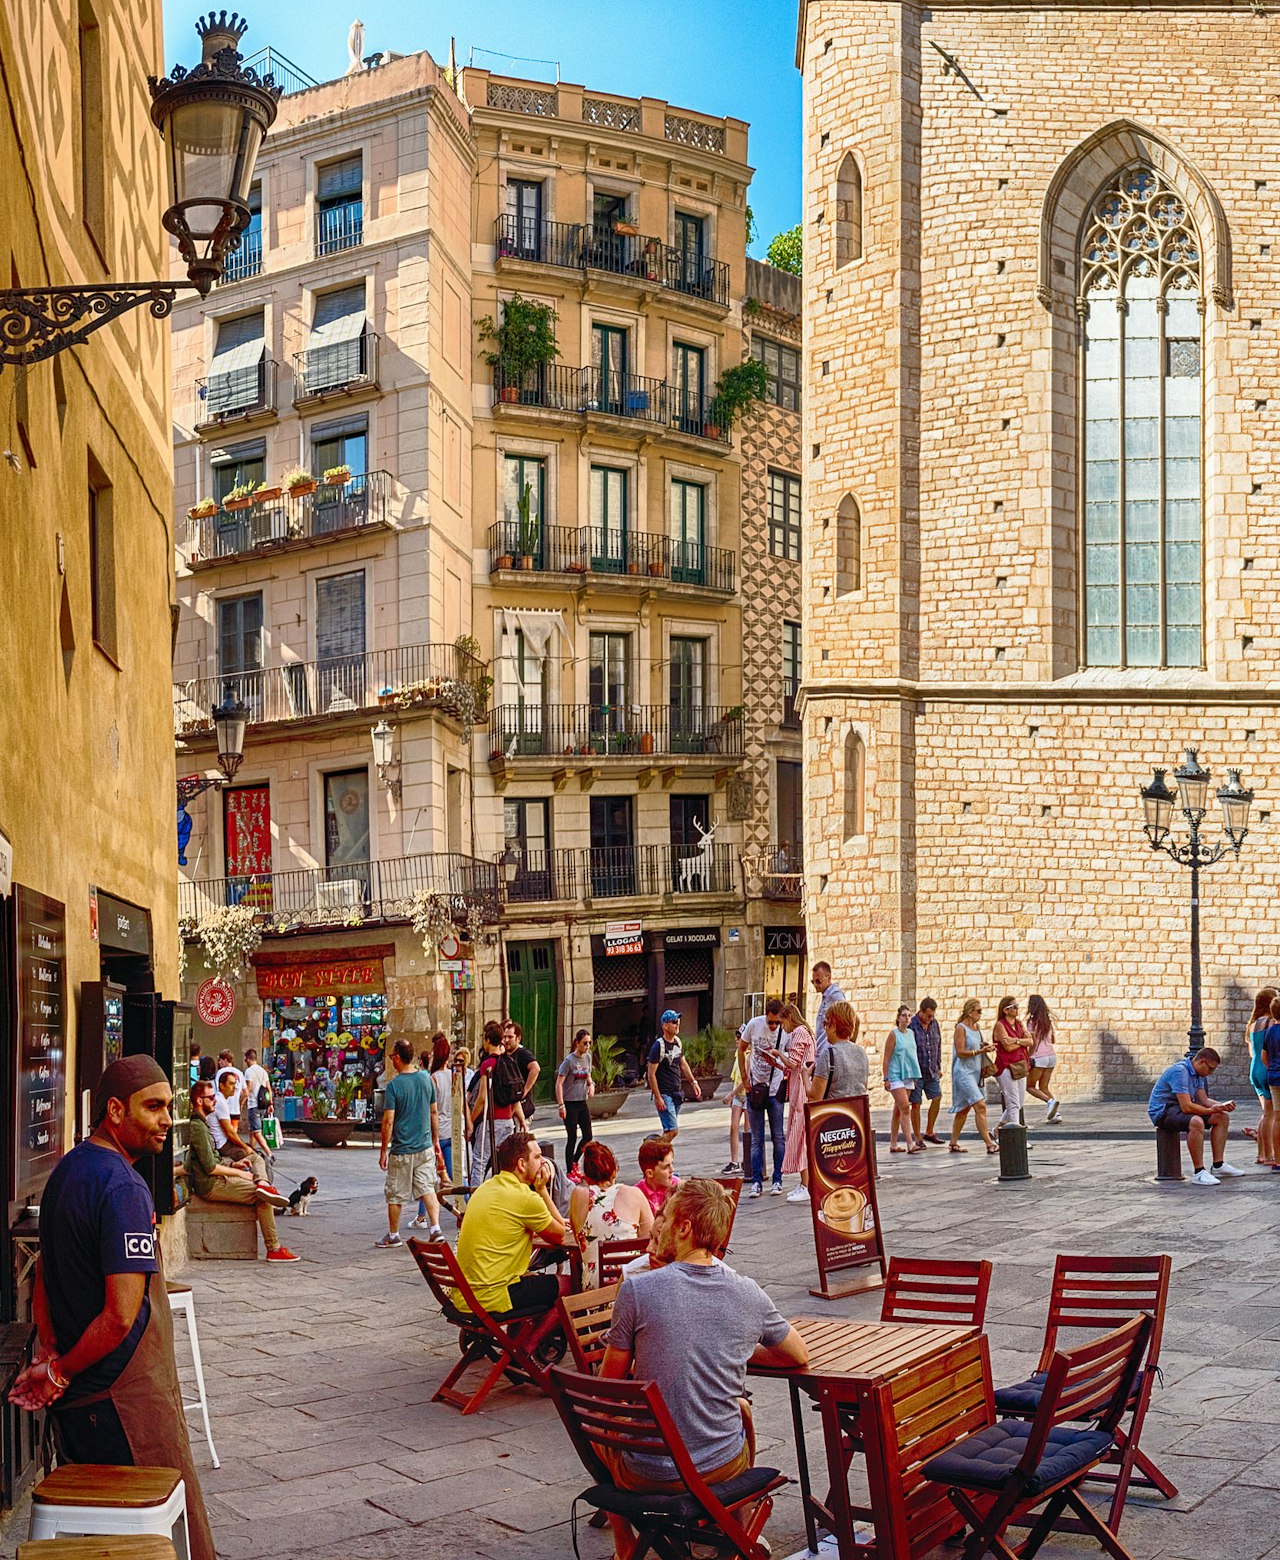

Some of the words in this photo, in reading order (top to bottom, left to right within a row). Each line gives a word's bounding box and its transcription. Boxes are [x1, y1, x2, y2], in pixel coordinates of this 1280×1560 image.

[608, 936, 639, 947] LLOGAT
[666, 935, 683, 943] GELAT
[688, 934, 717, 942] XOCOLATA
[606, 946, 614, 955] 93
[626, 944, 634, 953] 36
[634, 943, 642, 951] 63
[265, 970, 306, 989] BCN
[313, 967, 374, 988] STYLE
